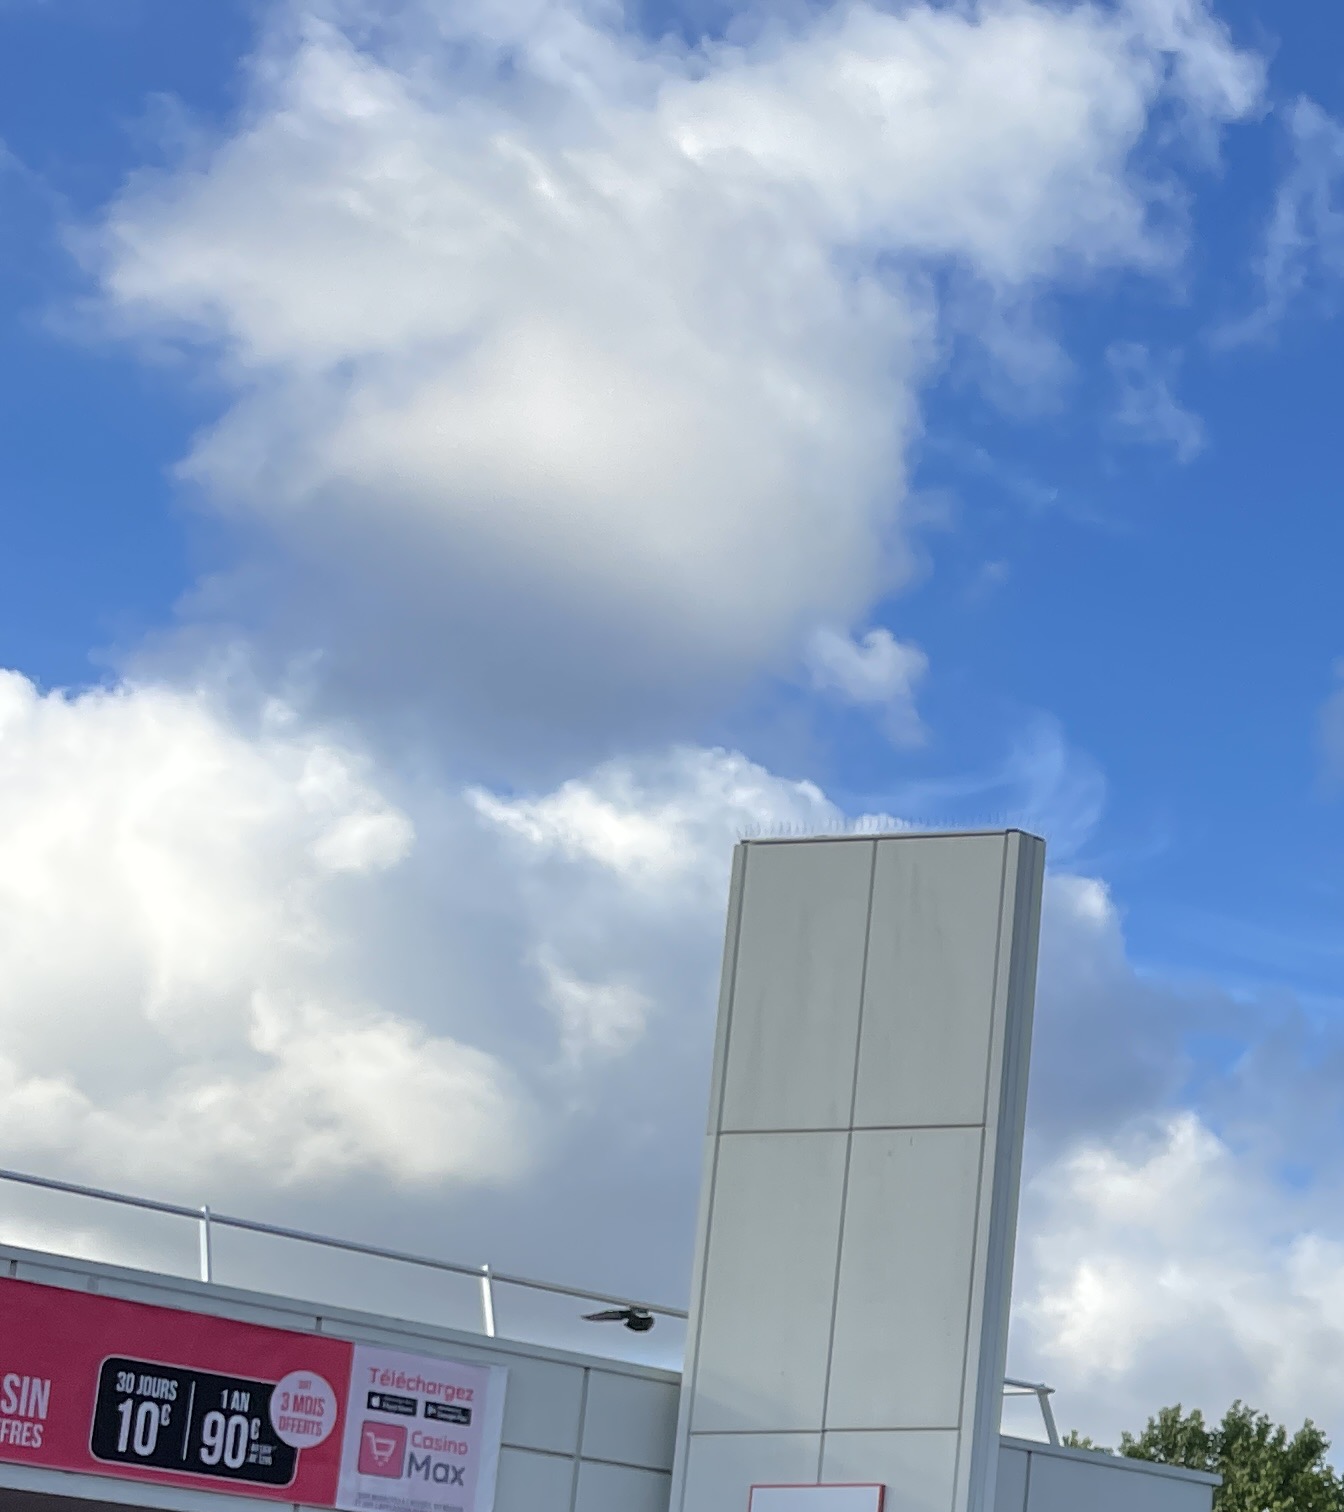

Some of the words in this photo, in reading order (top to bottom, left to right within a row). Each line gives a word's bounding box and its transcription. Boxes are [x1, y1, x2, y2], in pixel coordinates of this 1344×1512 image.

[116, 1371, 132, 1394] 30
[136, 1375, 178, 1401] JOURS
[368, 1367, 475, 1402] Téléchargez
[221, 1389, 228, 1410] 1
[231, 1391, 251, 1412] AN
[280, 1392, 290, 1411] 3
[293, 1394, 326, 1417] MOIS
[279, 1416, 323, 1437] OFFERTS
[411, 1430, 469, 1456] Casino
[407, 1451, 466, 1487] Max
